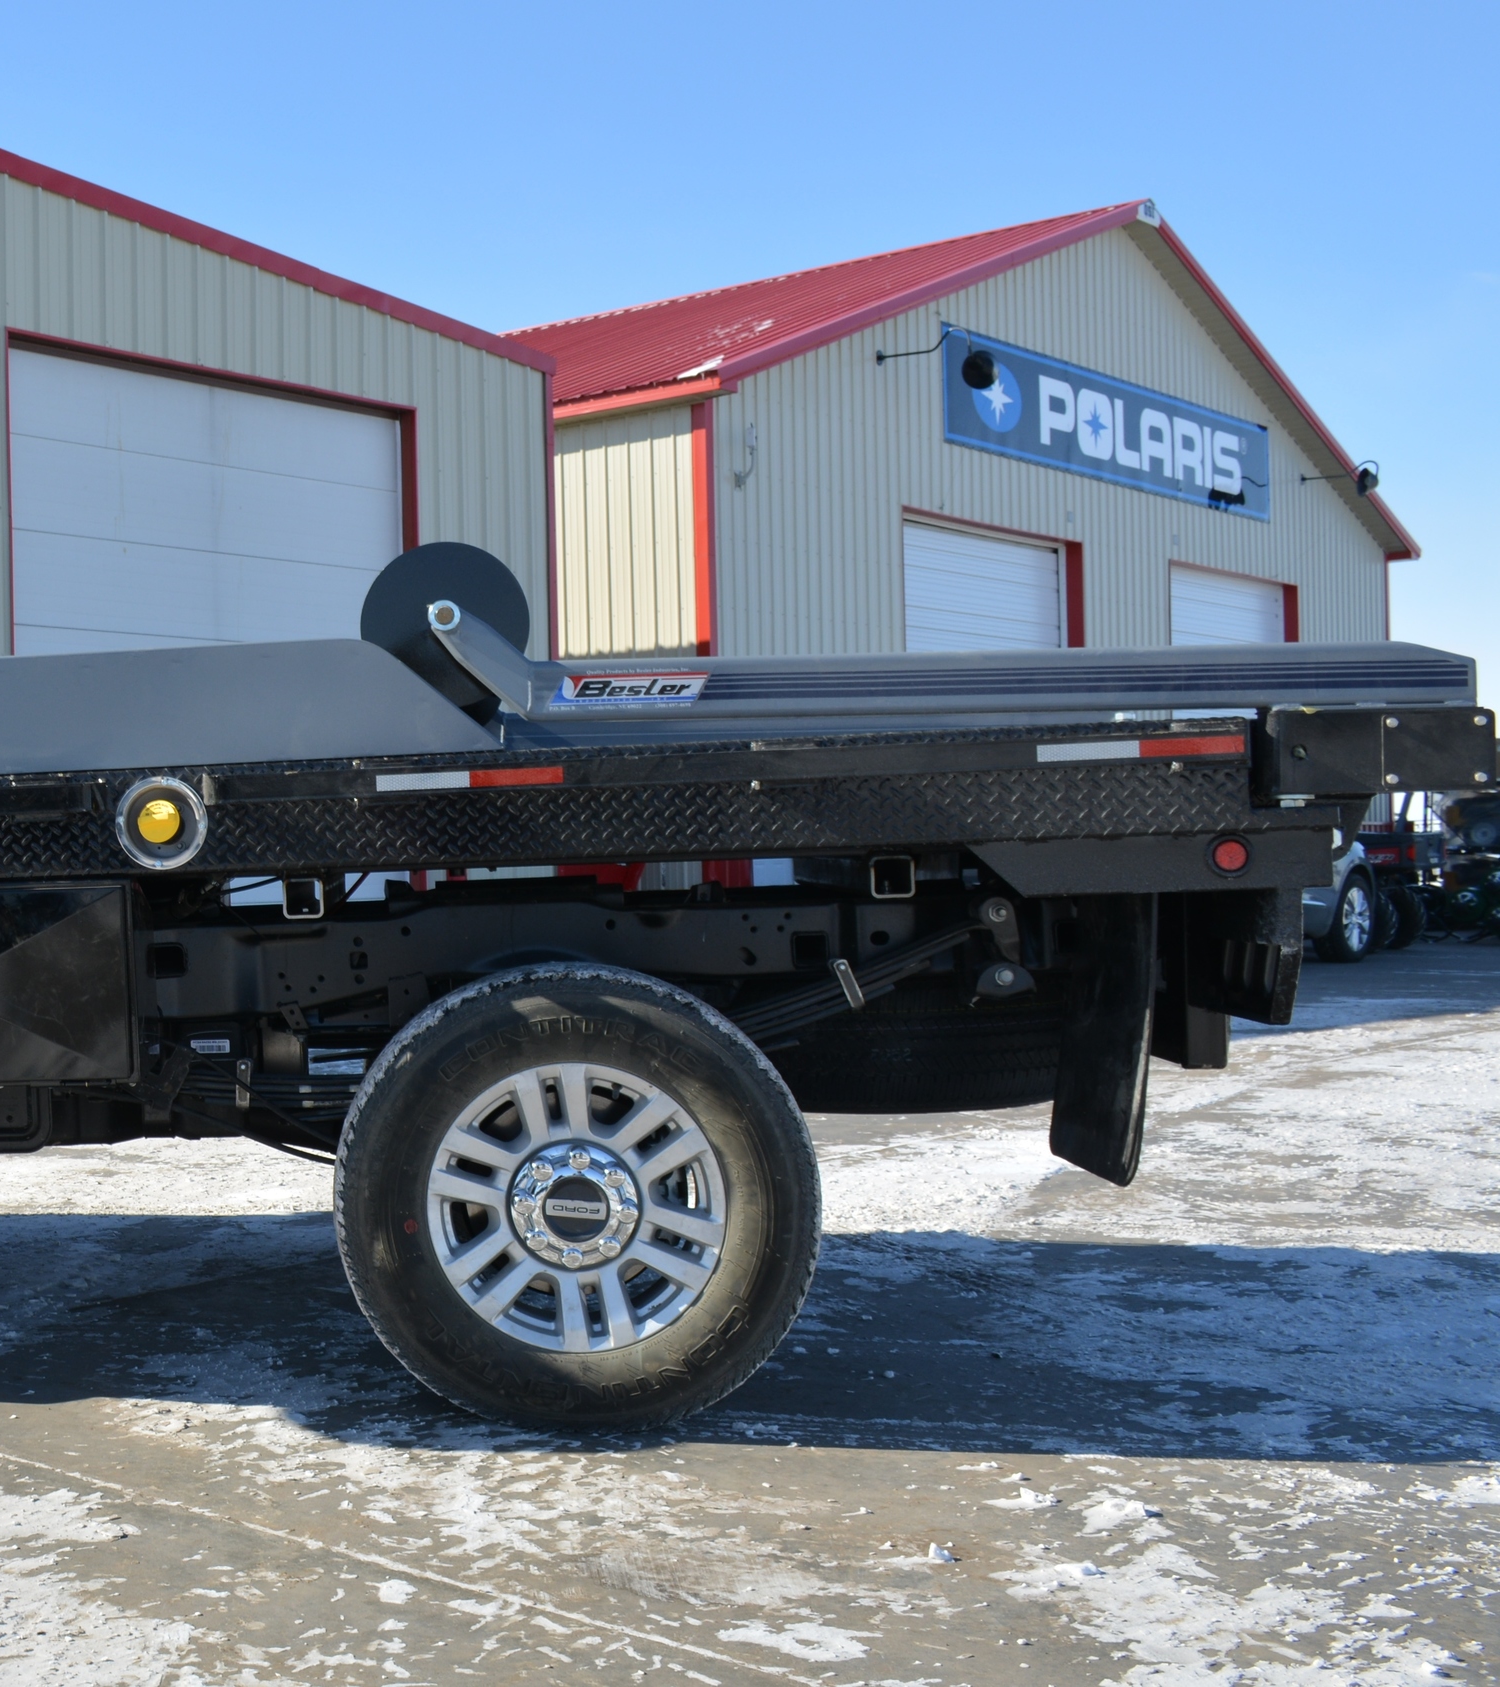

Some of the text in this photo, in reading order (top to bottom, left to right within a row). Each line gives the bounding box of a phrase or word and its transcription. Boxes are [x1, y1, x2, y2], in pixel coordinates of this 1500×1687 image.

[1038, 374, 1242, 496] POLARIS
[574, 678, 692, 698] Besler
[552, 1204, 600, 1215] FORD
